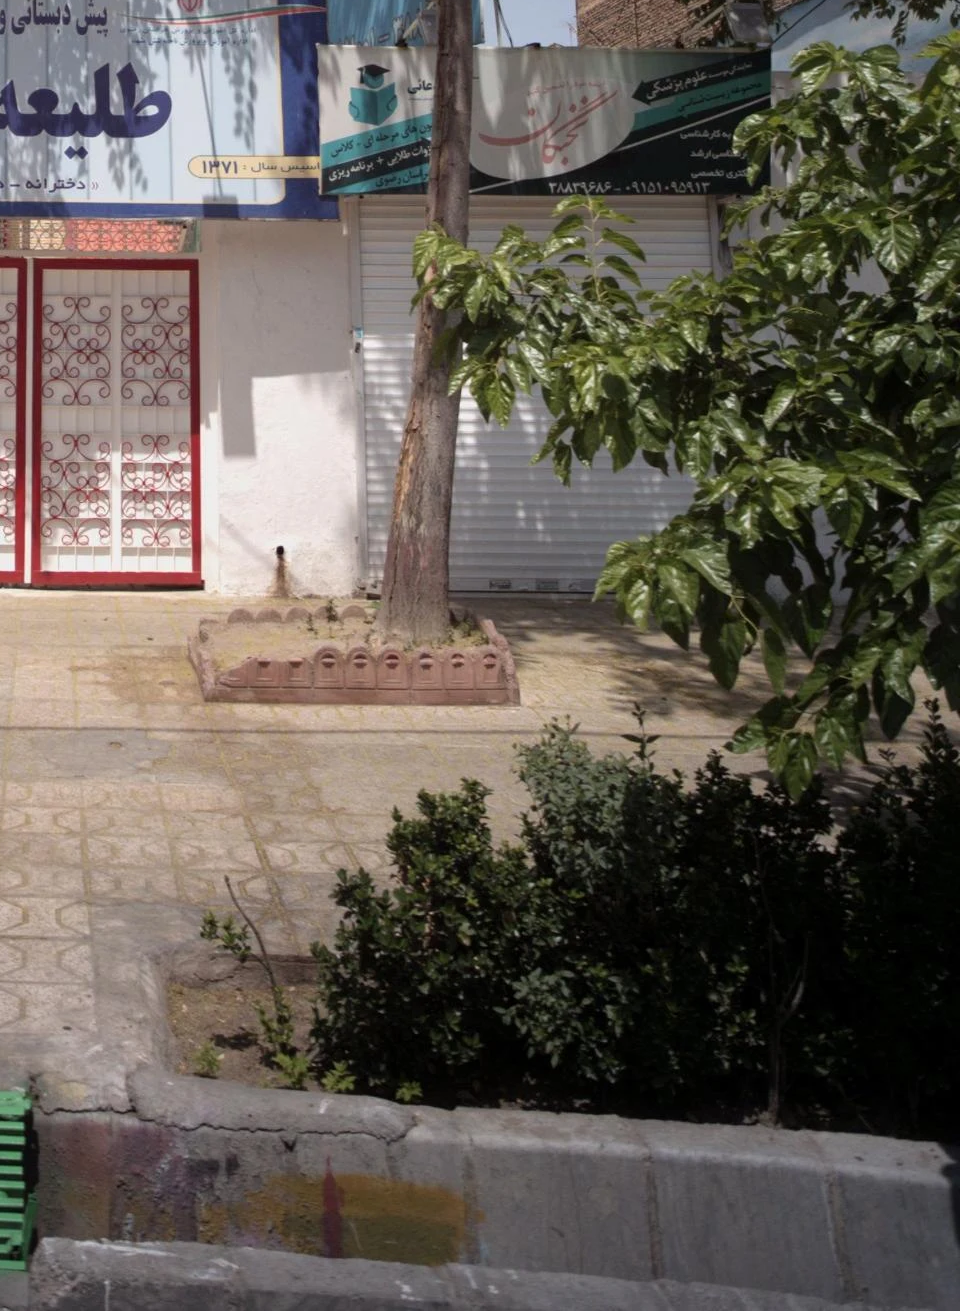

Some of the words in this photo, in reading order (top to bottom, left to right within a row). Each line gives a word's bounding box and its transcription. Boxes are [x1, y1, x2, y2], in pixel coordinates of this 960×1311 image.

[75, 0, 108, 37] پیش
[684, 70, 708, 87] علوم
[646, 78, 685, 100] پزشکی
[202, 160, 239, 175] ۱۳۷۱
[250, 161, 278, 173] سال
[280, 161, 319, 174] اسیس
